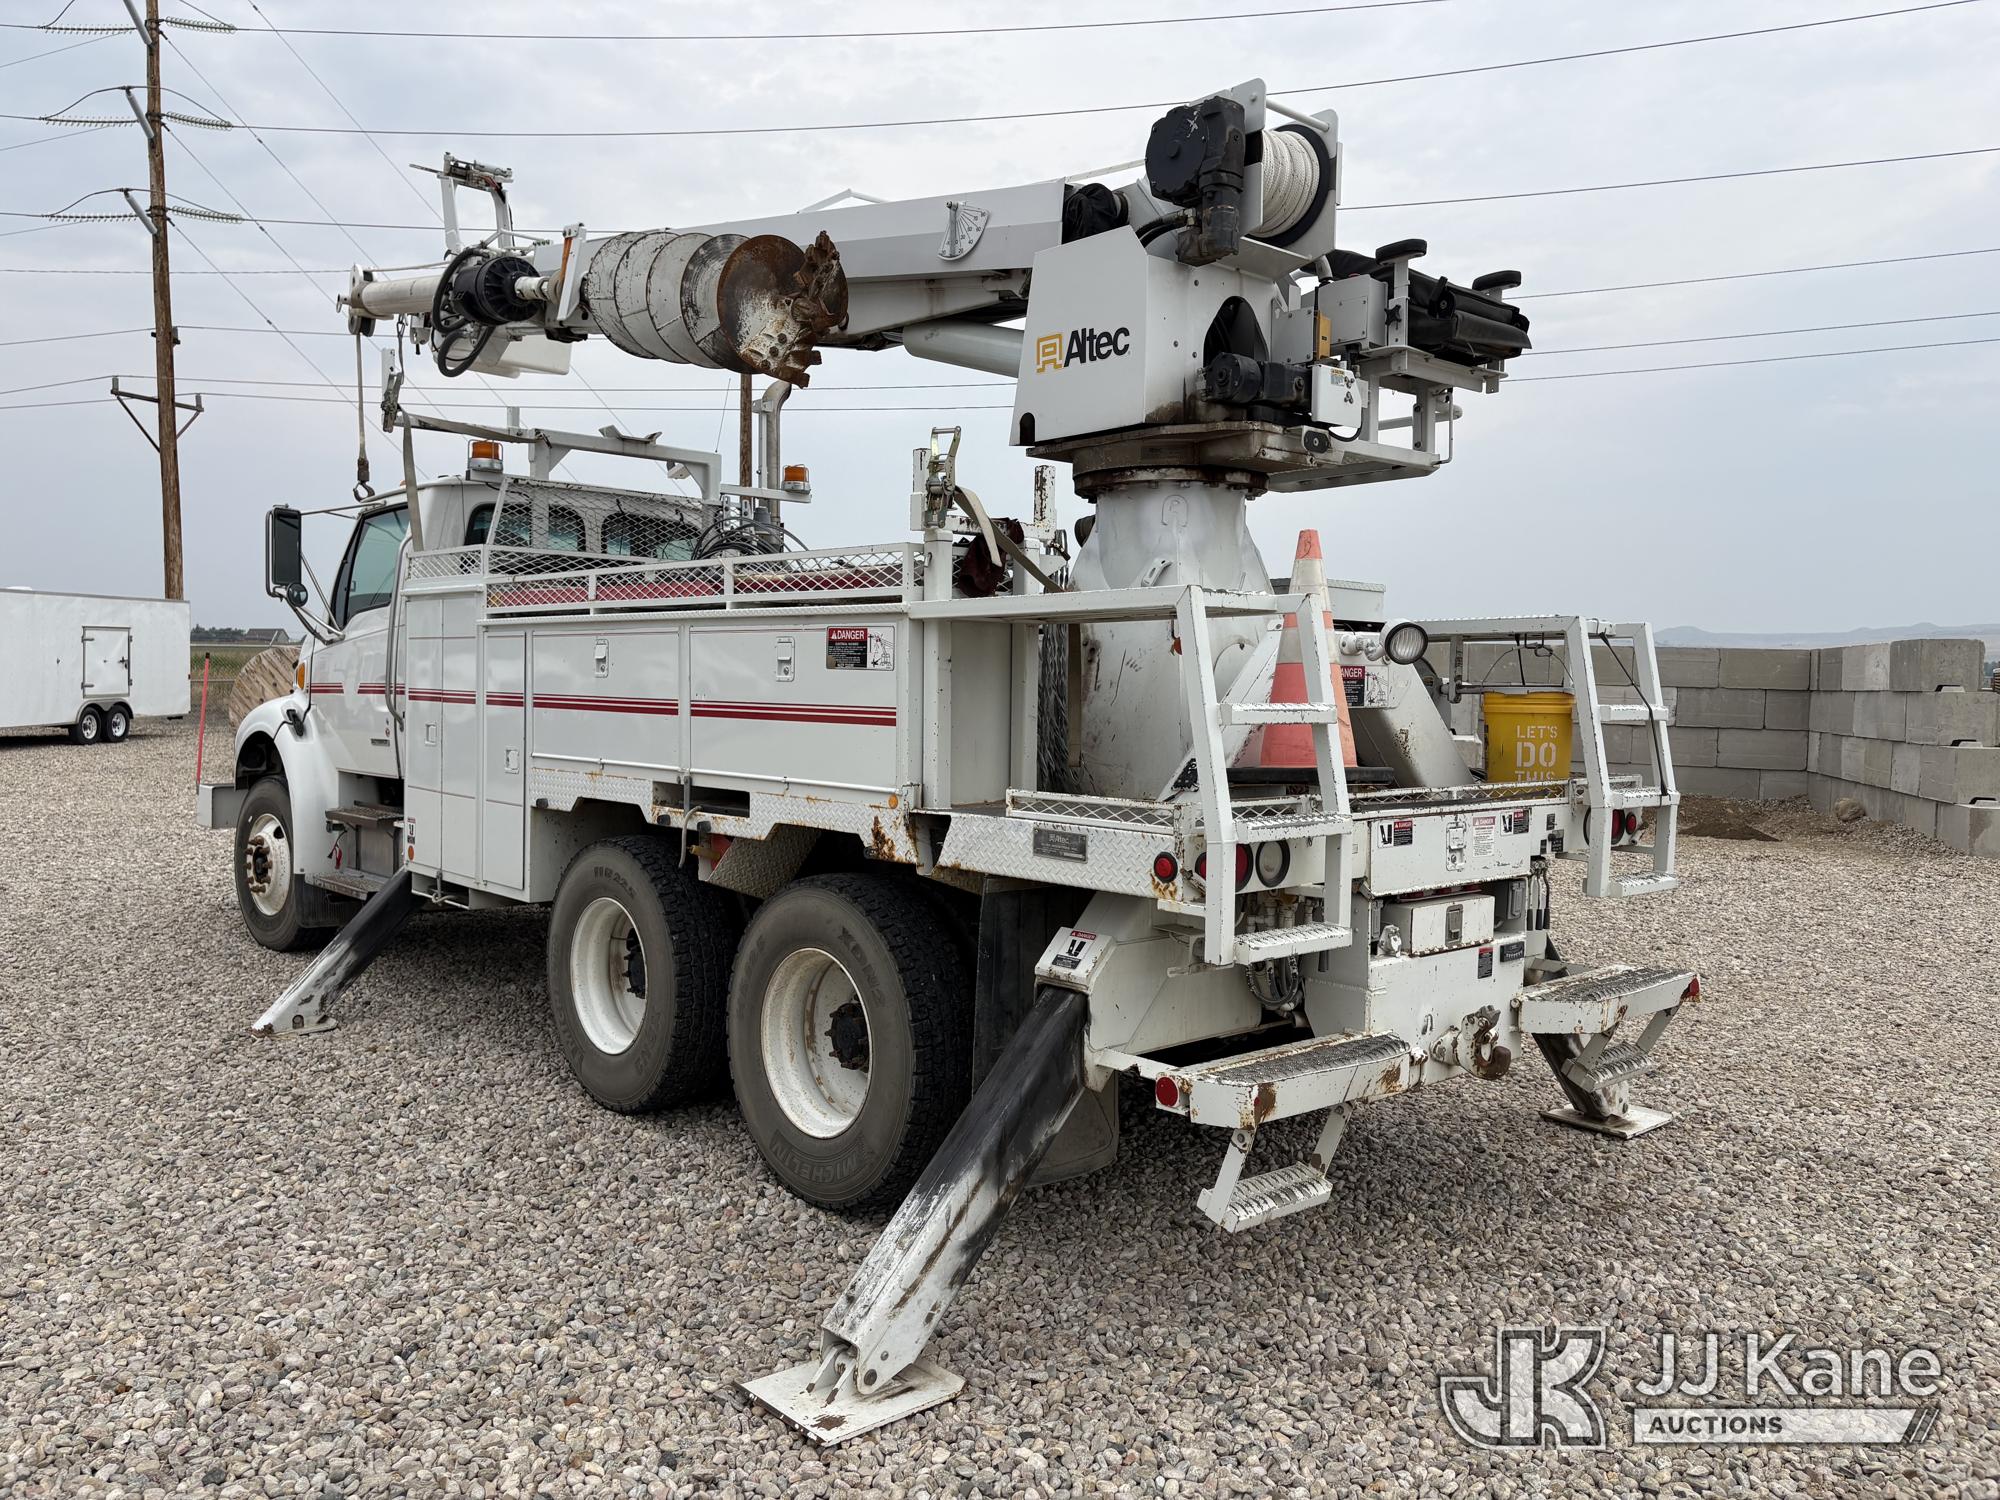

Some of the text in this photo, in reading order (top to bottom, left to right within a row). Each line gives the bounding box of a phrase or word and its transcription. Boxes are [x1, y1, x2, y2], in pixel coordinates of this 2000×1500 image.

[1064, 327, 1130, 367] Altec
[838, 630, 865, 640] DANGER
[1341, 667, 1363, 678] ANGER
[1516, 725, 1558, 739] LET'S
[1516, 741, 1557, 768] DO
